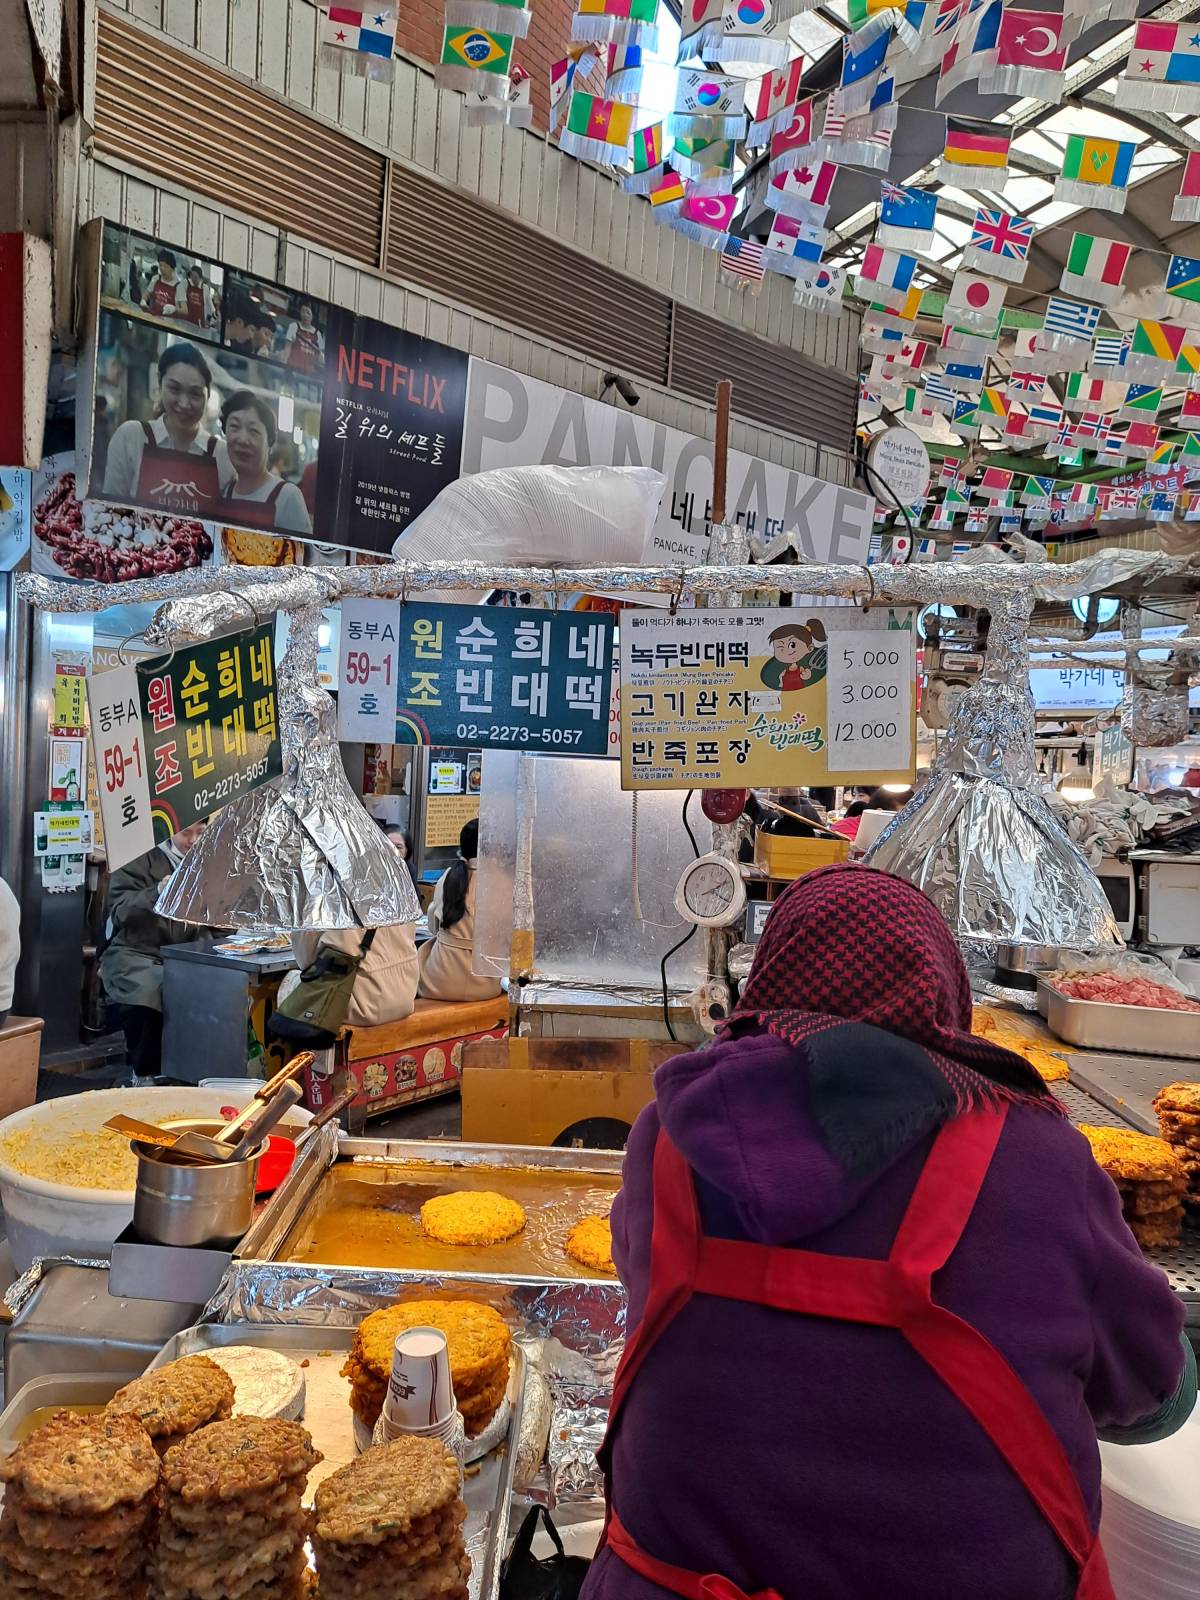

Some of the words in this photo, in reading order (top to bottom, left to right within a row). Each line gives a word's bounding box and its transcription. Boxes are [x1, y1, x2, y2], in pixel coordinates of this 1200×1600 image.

[336, 344, 447, 414] NETFLIX
[336, 397, 364, 411] NETFLIX
[334, 407, 352, 439] 길
[358, 417, 392, 440] 위의
[357, 481, 377, 492] 2019년
[361, 508, 387, 520] 대한민국
[388, 512, 401, 524] 서울
[653, 537, 697, 560] PANCAKE,
[347, 621, 395, 643] 동부A
[650, 617, 674, 627] 먹다가
[702, 617, 726, 627] 죽어도
[728, 616, 744, 627] 모를
[456, 616, 605, 670] 순희네
[631, 641, 749, 669] 녹두빈대떡
[346, 651, 391, 685] 59-1
[843, 649, 899, 669] 5.000
[180, 636, 273, 719] 순희네
[1059, 668, 1105, 689] 박가네
[357, 693, 380, 716] 호
[455, 669, 603, 720] 빈대떡
[631, 691, 751, 717] 고기완자
[842, 685, 898, 704] 3.000
[99, 698, 138, 733] 동부A
[185, 692, 277, 781] 빈대떡
[456, 723, 583, 745] 02-2273-5057
[770, 727, 825, 752] 빈대떡
[835, 723, 897, 741] 12.000
[103, 737, 142, 793] 59-1
[632, 739, 751, 766] 반죽포장
[194, 757, 269, 811] 02-2273-5057
[121, 795, 139, 828] 호
